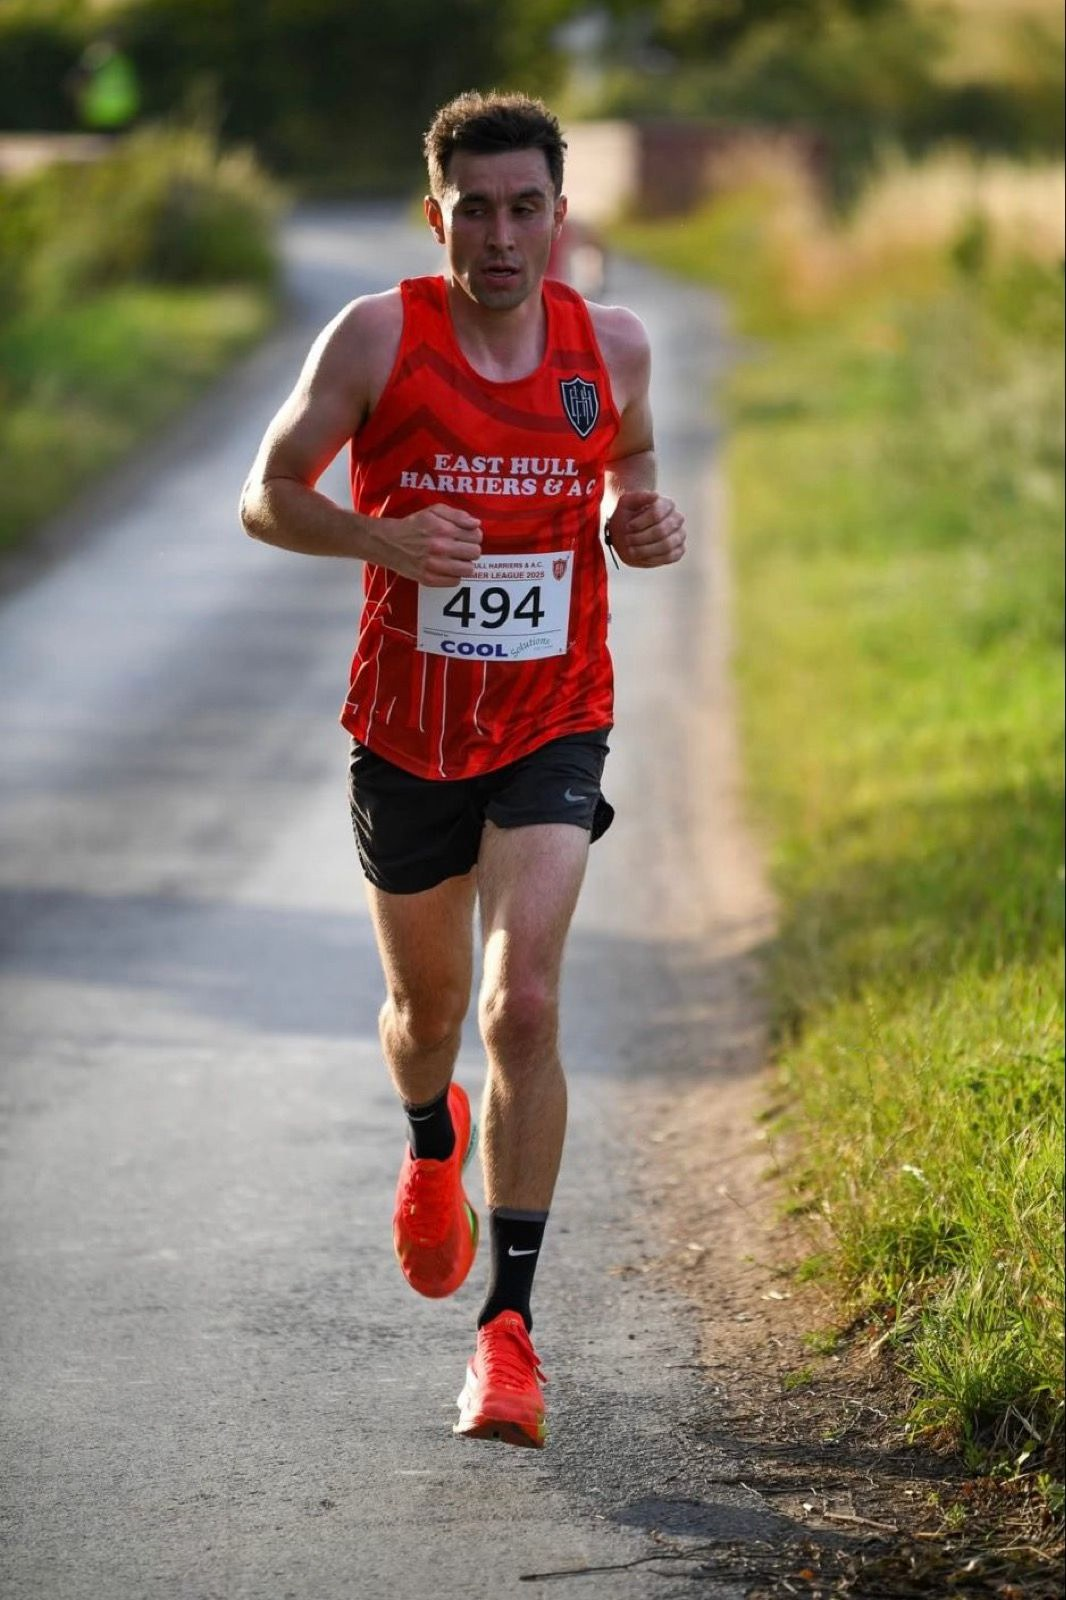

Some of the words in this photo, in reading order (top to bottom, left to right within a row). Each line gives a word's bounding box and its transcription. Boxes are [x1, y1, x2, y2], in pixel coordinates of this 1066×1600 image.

[434, 454, 504, 474] EAST
[510, 457, 579, 476] HULL
[400, 471, 537, 495] HARRIERS
[543, 478, 563, 496] &
[567, 480, 582, 496] A
[491, 571, 524, 579] LEAGUE
[443, 586, 545, 629] 494
[440, 640, 508, 657] COOL
